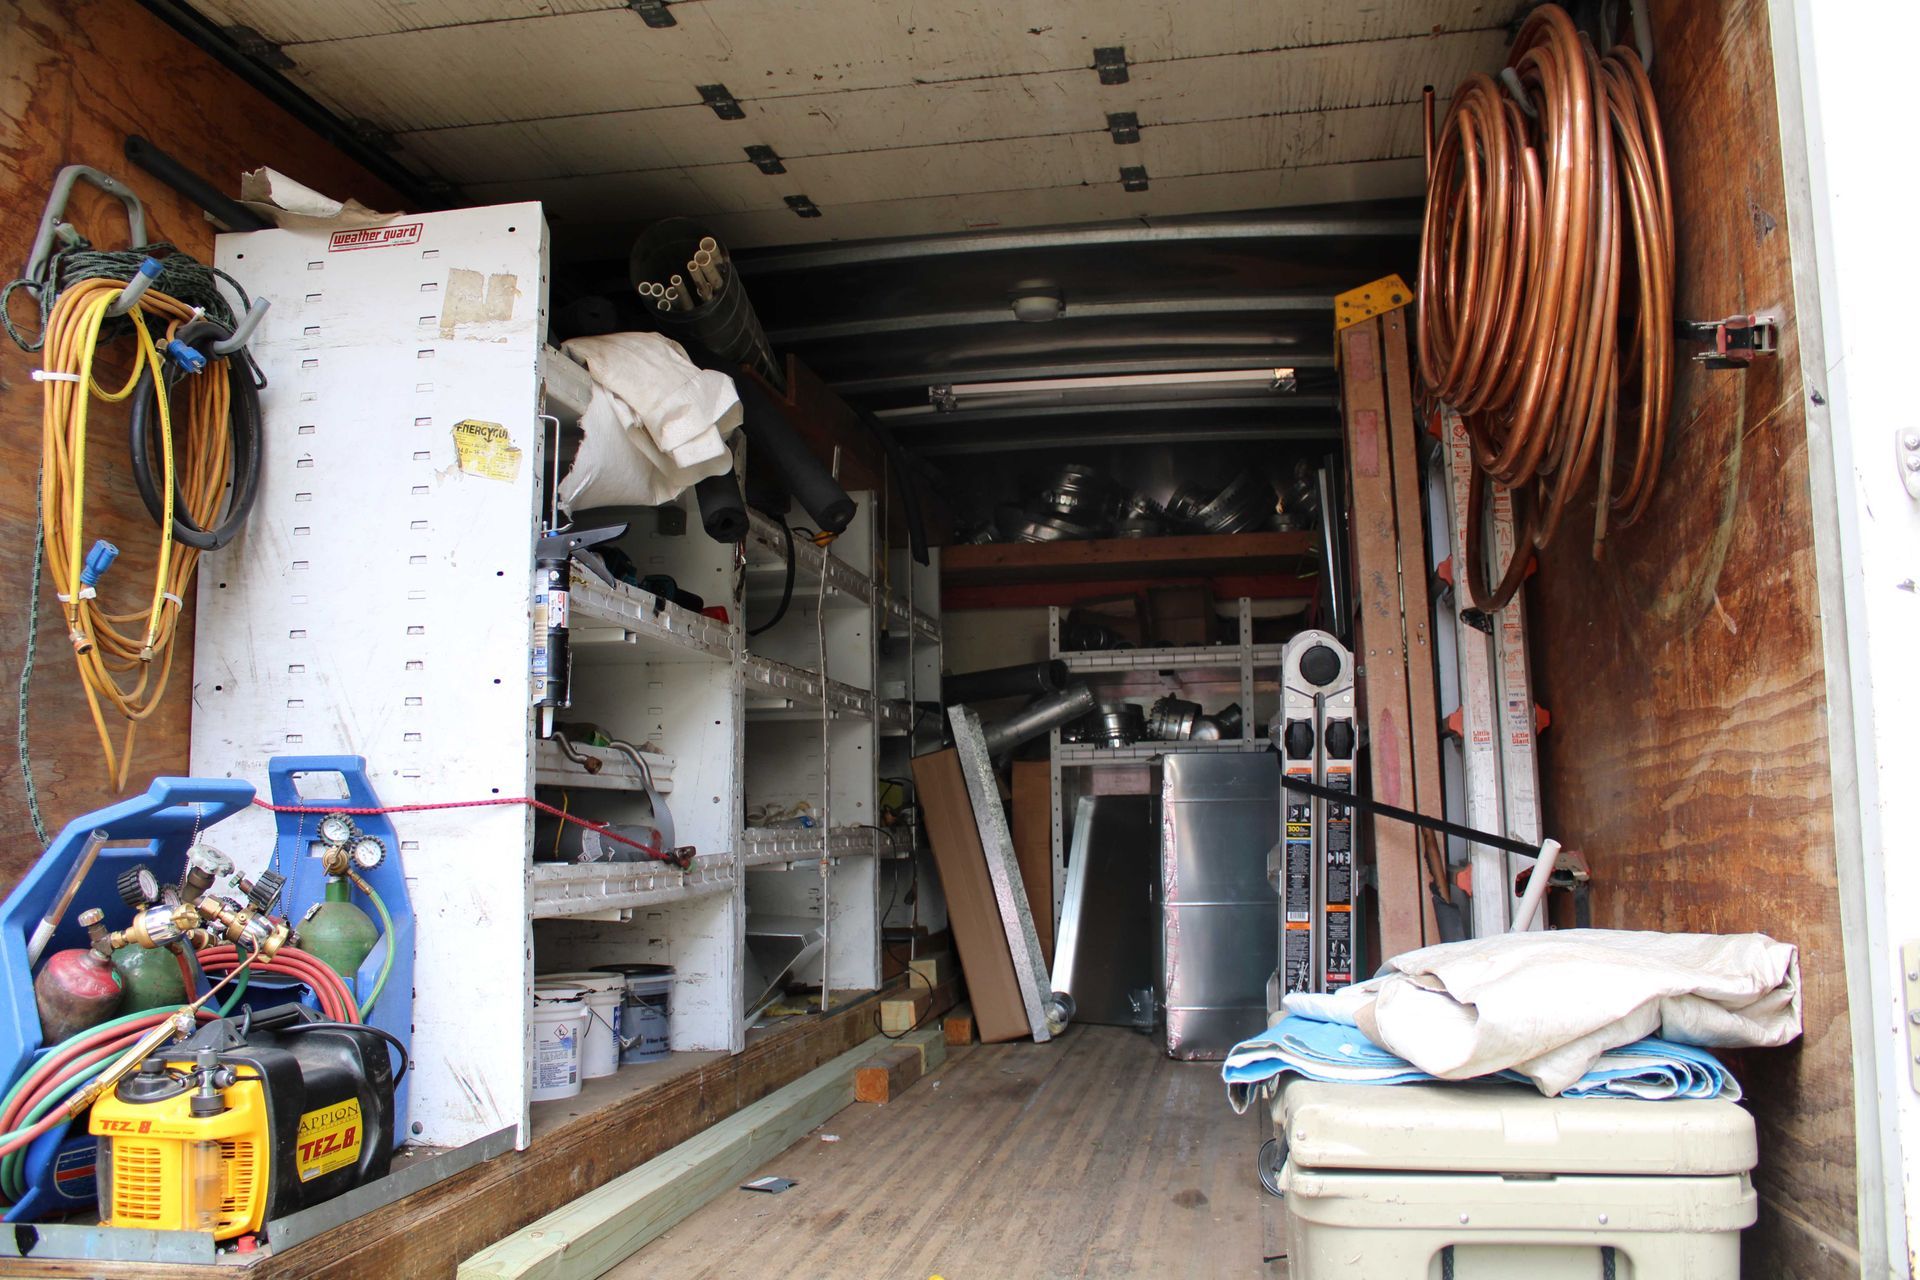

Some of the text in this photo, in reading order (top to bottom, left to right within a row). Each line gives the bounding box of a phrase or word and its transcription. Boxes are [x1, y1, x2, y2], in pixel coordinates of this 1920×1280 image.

[333, 225, 418, 245] weather guard
[1288, 825, 1300, 833] 300
[99, 1119, 153, 1134] TEZ 8
[299, 1103, 359, 1134] APPION
[298, 1132, 342, 1162] TEZ
[342, 1125, 357, 1150] 8
